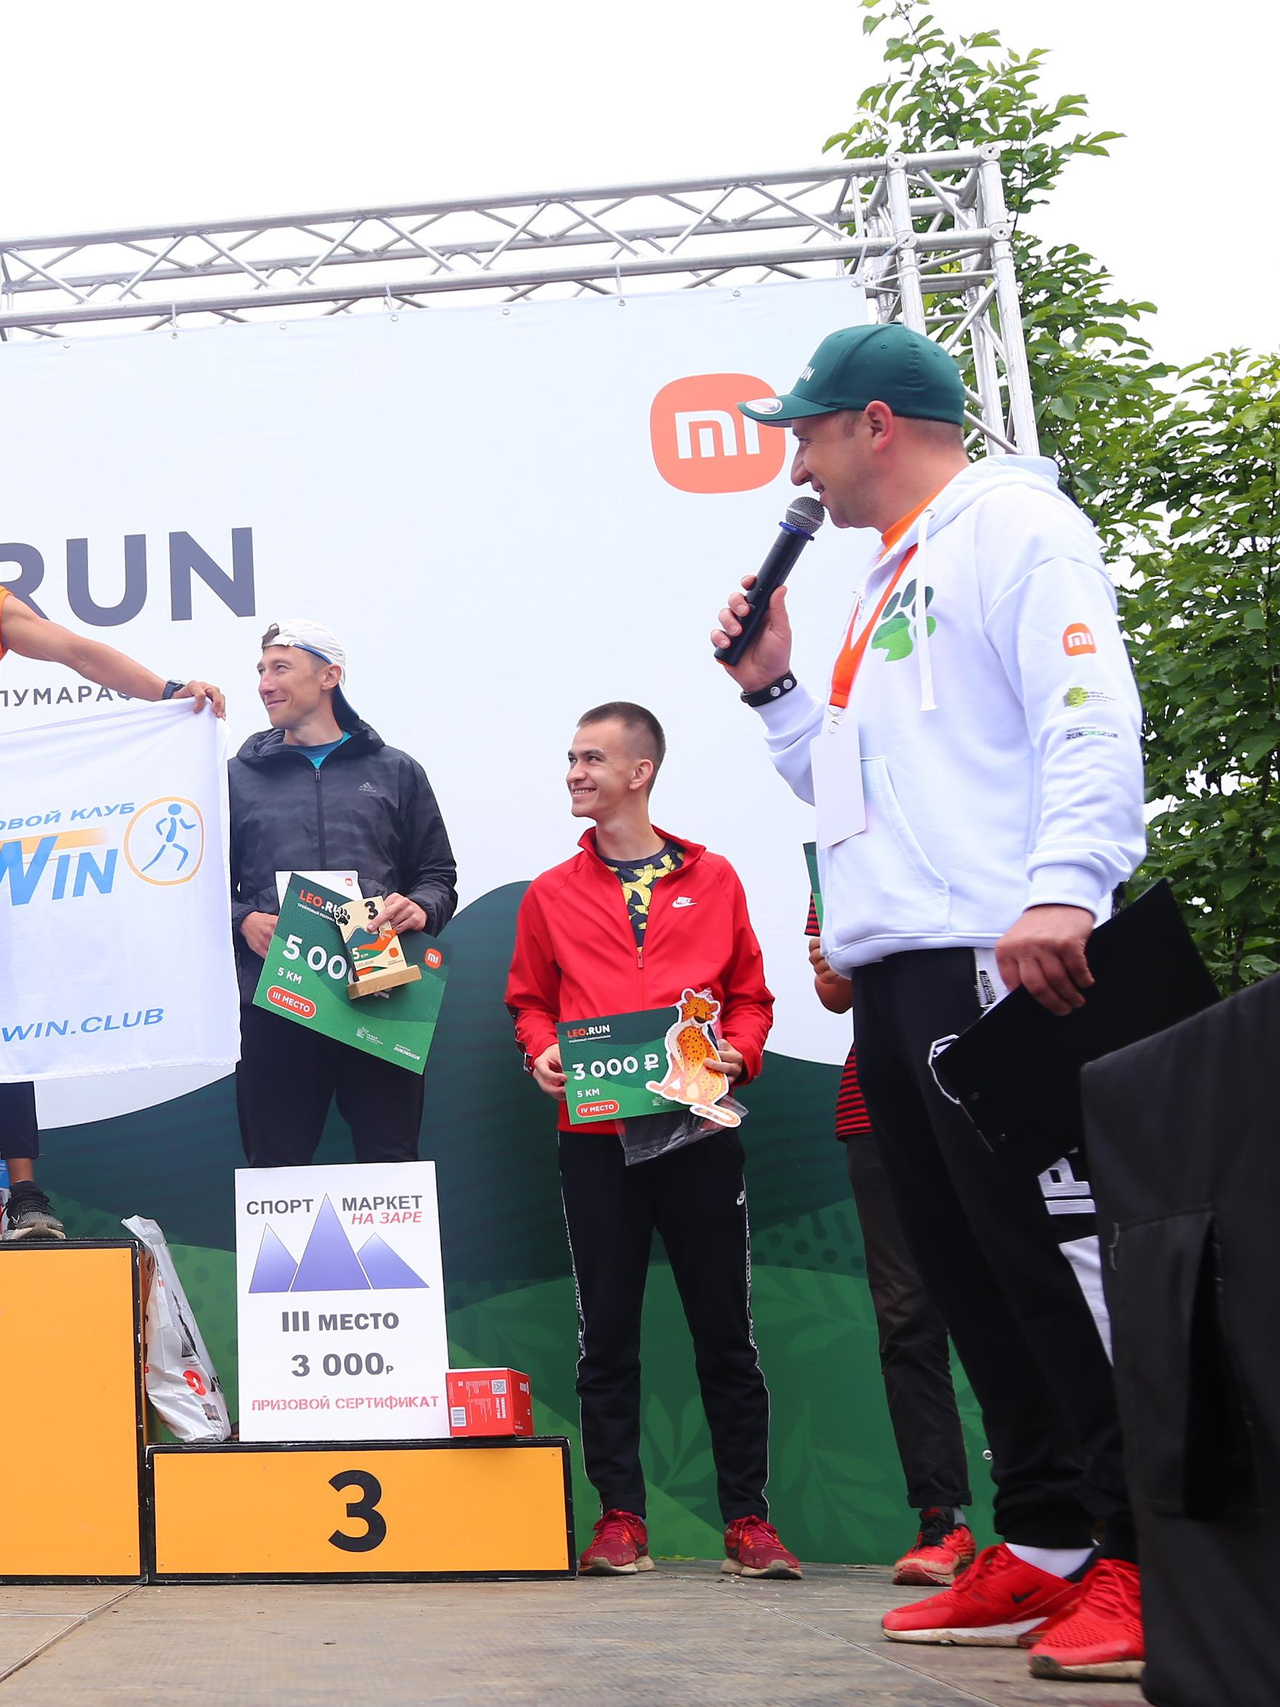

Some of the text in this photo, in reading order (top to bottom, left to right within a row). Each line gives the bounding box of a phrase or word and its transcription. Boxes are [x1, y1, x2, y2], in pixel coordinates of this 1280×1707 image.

[70, 802, 135, 820] КЛУБ
[365, 901, 378, 920] 3
[282, 934, 303, 960] 5
[352, 948, 360, 959] 5
[277, 966, 285, 976] 5
[282, 995, 310, 1013] МЕСТО
[567, 1025, 610, 1037] LEO.RUN
[572, 1063, 586, 1080] 3
[591, 1056, 638, 1078] 000
[577, 1090, 583, 1098] 5
[590, 1104, 614, 1112] МЕСТО
[246, 1195, 423, 1215] СПОРТ МАРКЕТ
[351, 1211, 422, 1225] НА ЗАРЕ
[281, 1311, 400, 1332] III МЕСТО
[291, 1354, 310, 1377] 3
[252, 1395, 439, 1411] ПРИЗОВОЙ СЕРТИФИКАТ
[327, 1470, 387, 1552] 3
